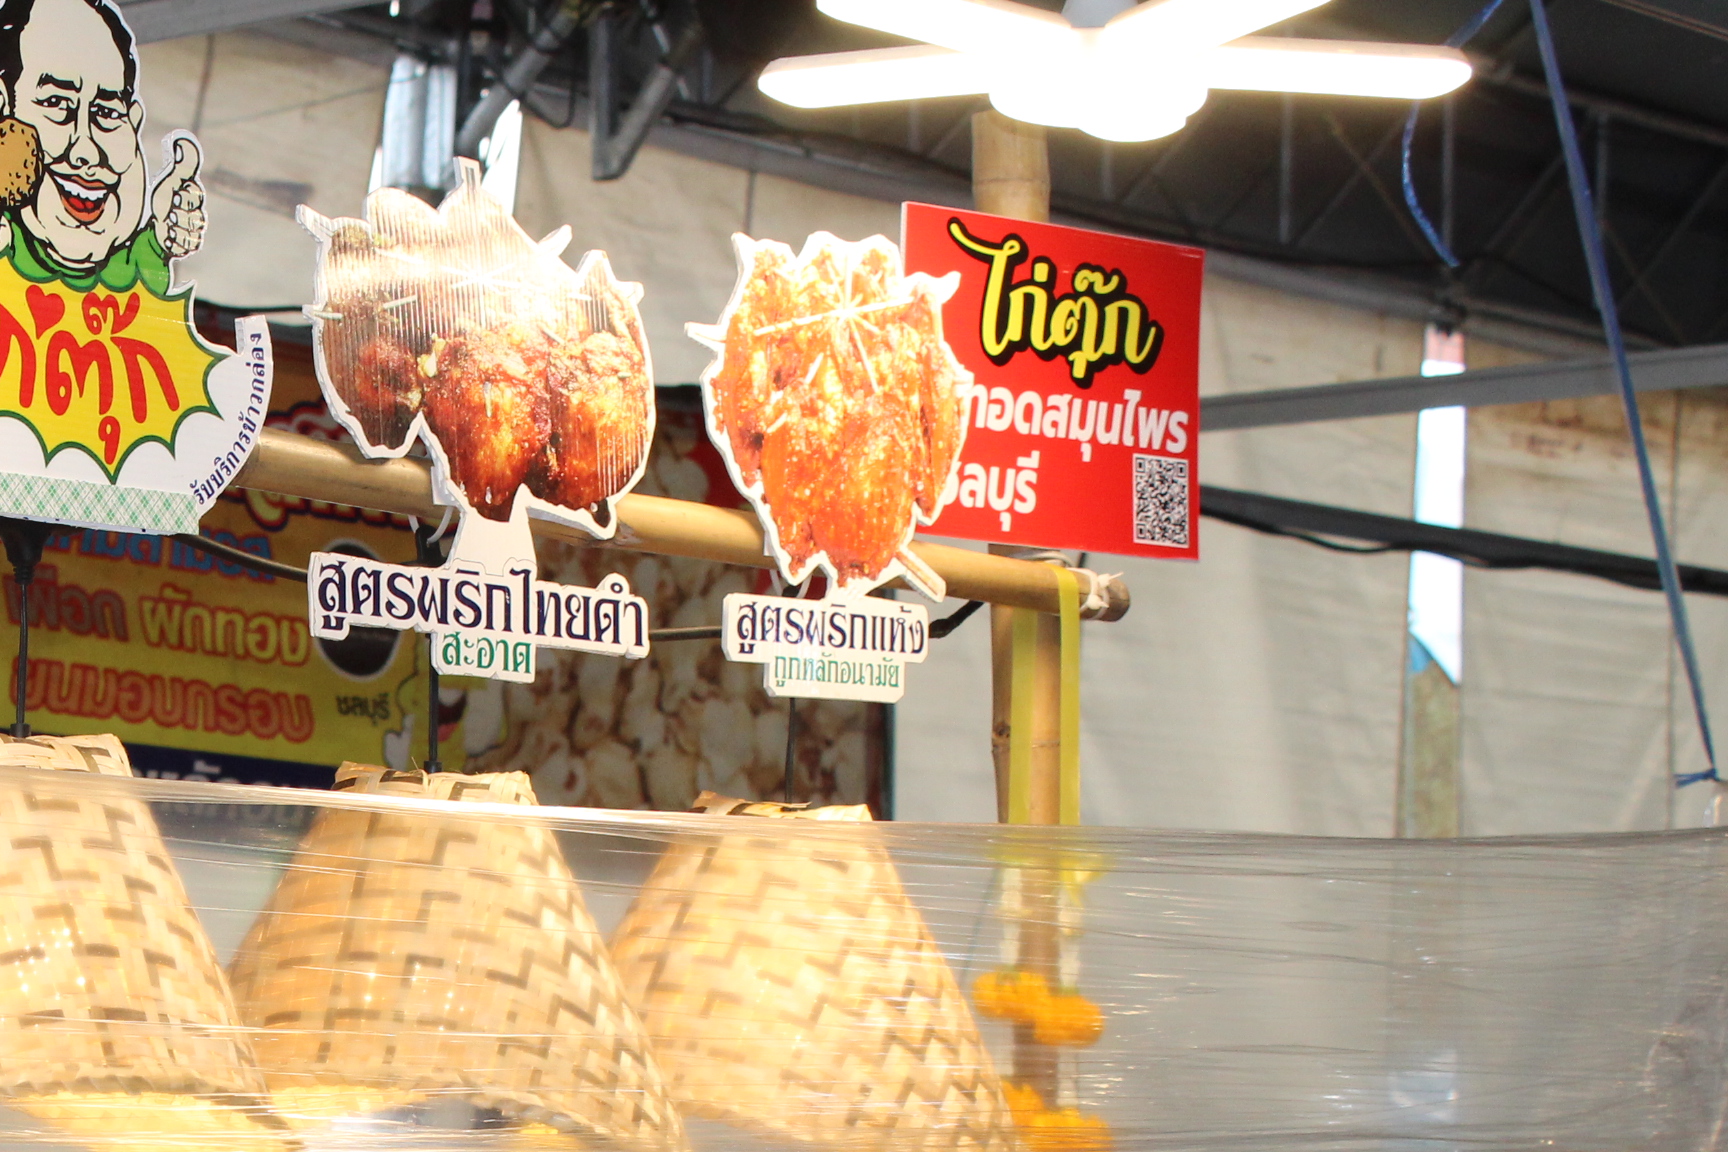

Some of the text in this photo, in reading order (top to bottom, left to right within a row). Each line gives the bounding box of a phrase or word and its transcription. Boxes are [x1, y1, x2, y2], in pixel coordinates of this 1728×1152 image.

[947, 220, 1158, 384] ไก่ตุ๊ก
[317, 560, 645, 648] สูตรพริกไทยดำ
[735, 599, 927, 657] สูตรพริกแห้ง
[441, 629, 533, 676] สะอาด
[335, 692, 391, 727] ชลบุรี
